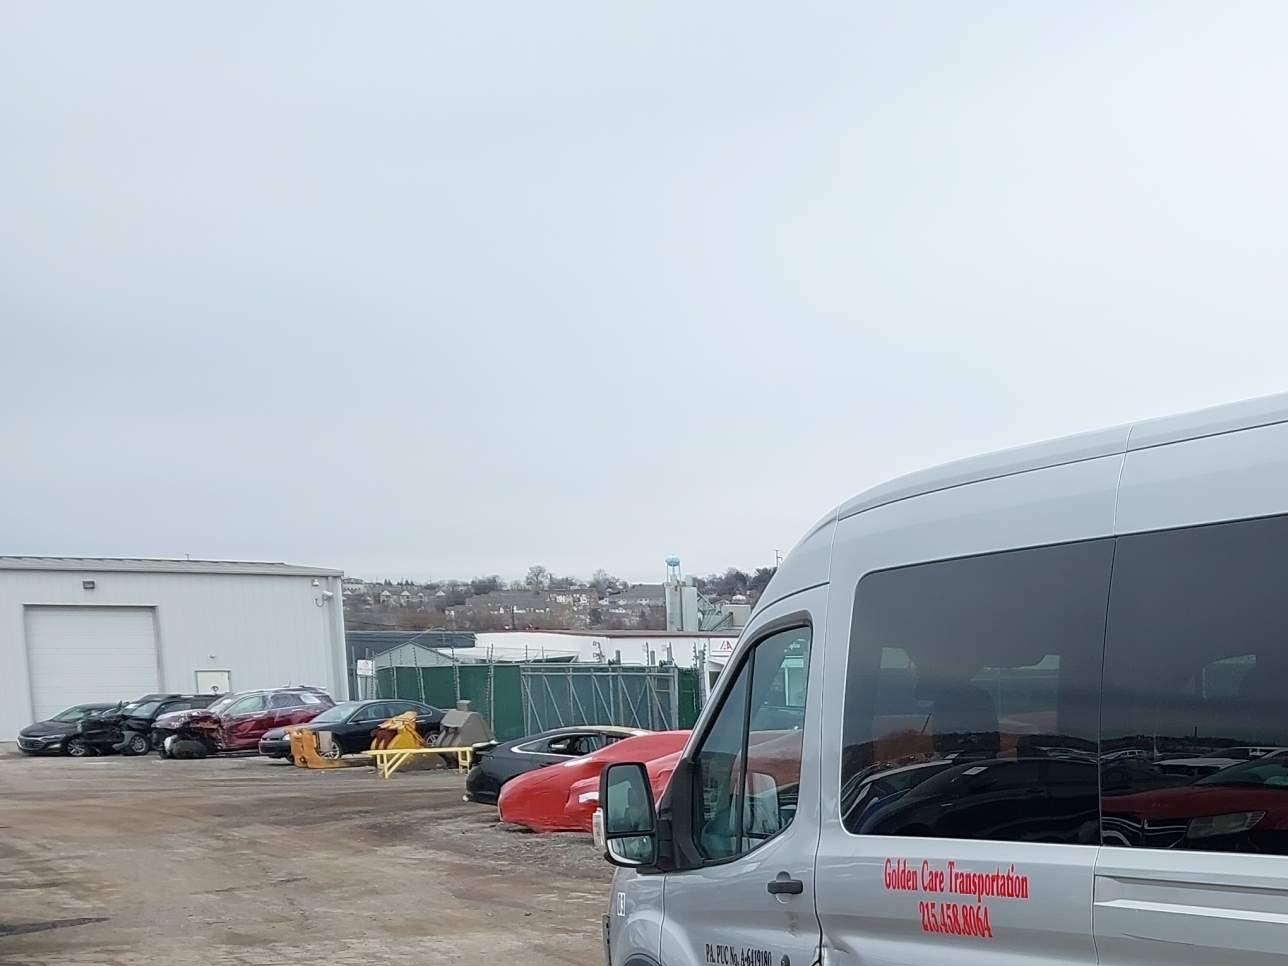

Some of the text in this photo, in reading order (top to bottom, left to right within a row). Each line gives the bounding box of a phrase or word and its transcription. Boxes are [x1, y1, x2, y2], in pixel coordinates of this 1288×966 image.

[884, 858, 1029, 902] Golden Care Transportation
[919, 901, 993, 938] 215.458.8064
[705, 943, 716, 963] PA.
[716, 945, 729, 965] PUC
[730, 946, 739, 966] No.
